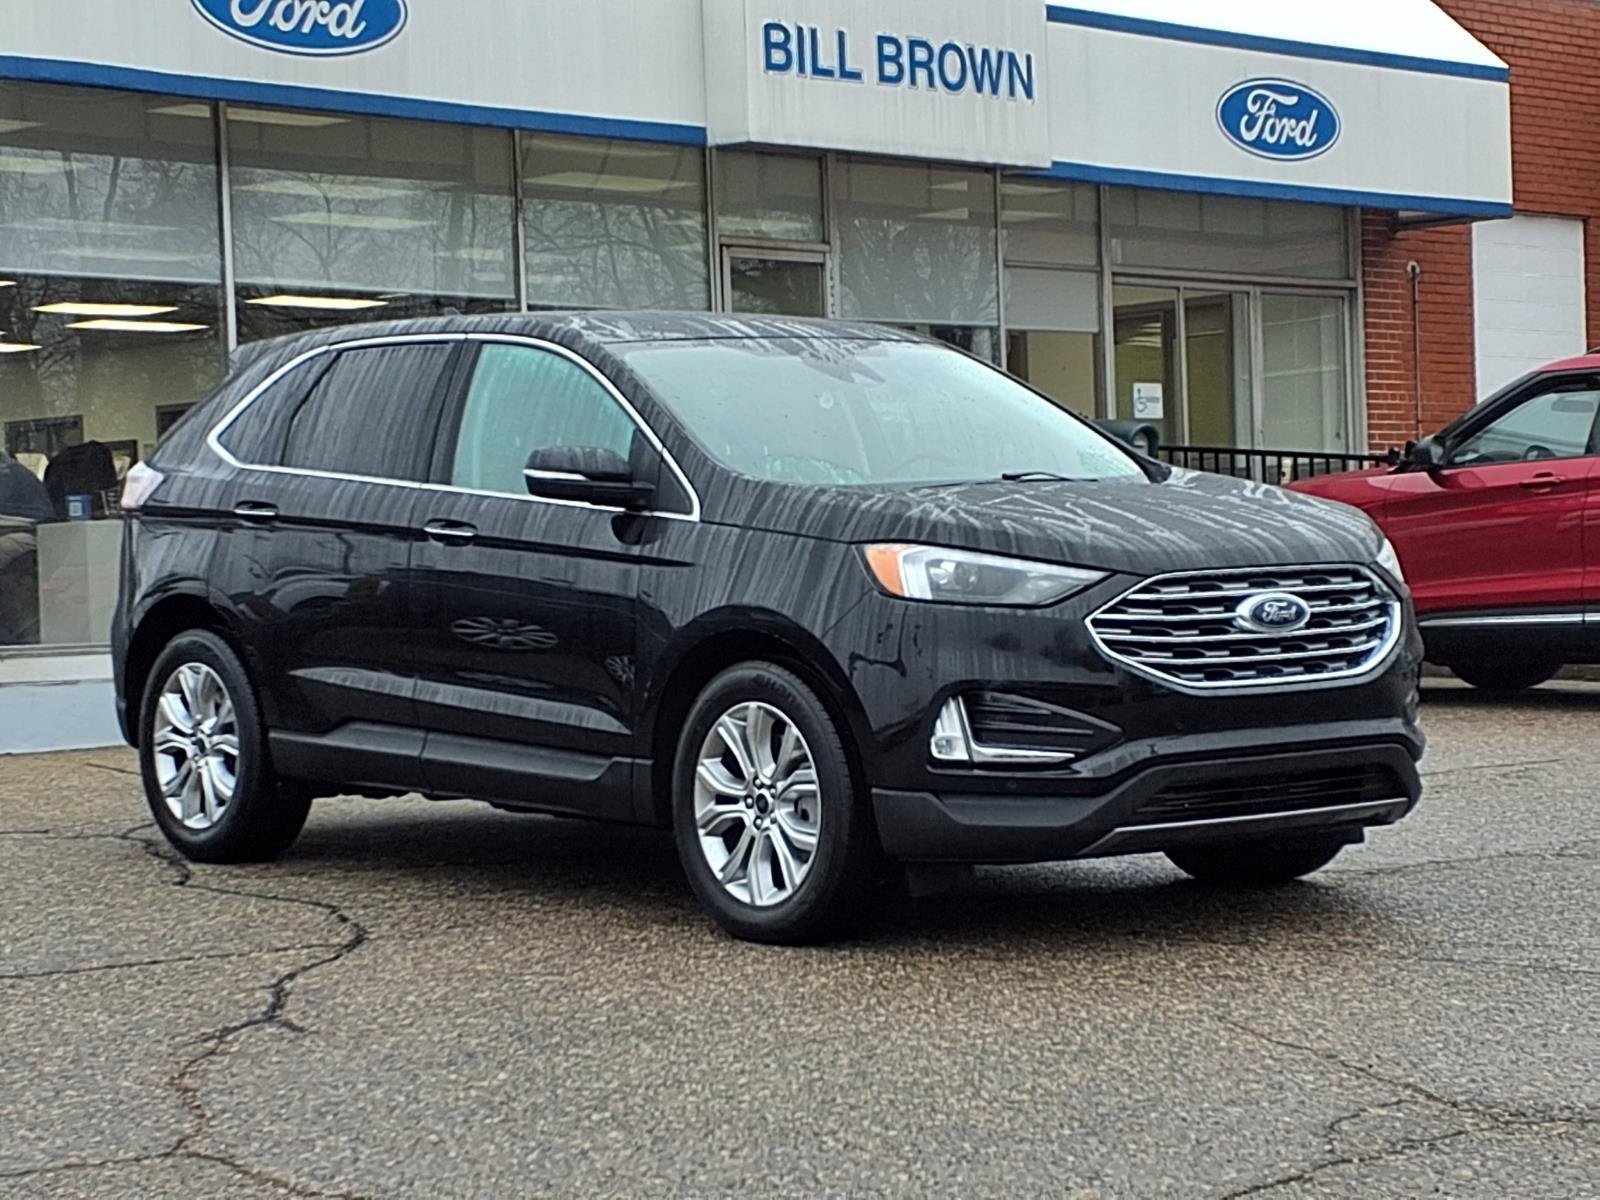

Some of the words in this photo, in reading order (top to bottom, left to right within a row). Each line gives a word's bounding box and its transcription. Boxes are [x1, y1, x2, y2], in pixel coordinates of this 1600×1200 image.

[763, 22, 863, 81] BILL
[876, 34, 1034, 101] BROWN
[1240, 88, 1318, 147] Ford
[1262, 601, 1297, 622] Ford
